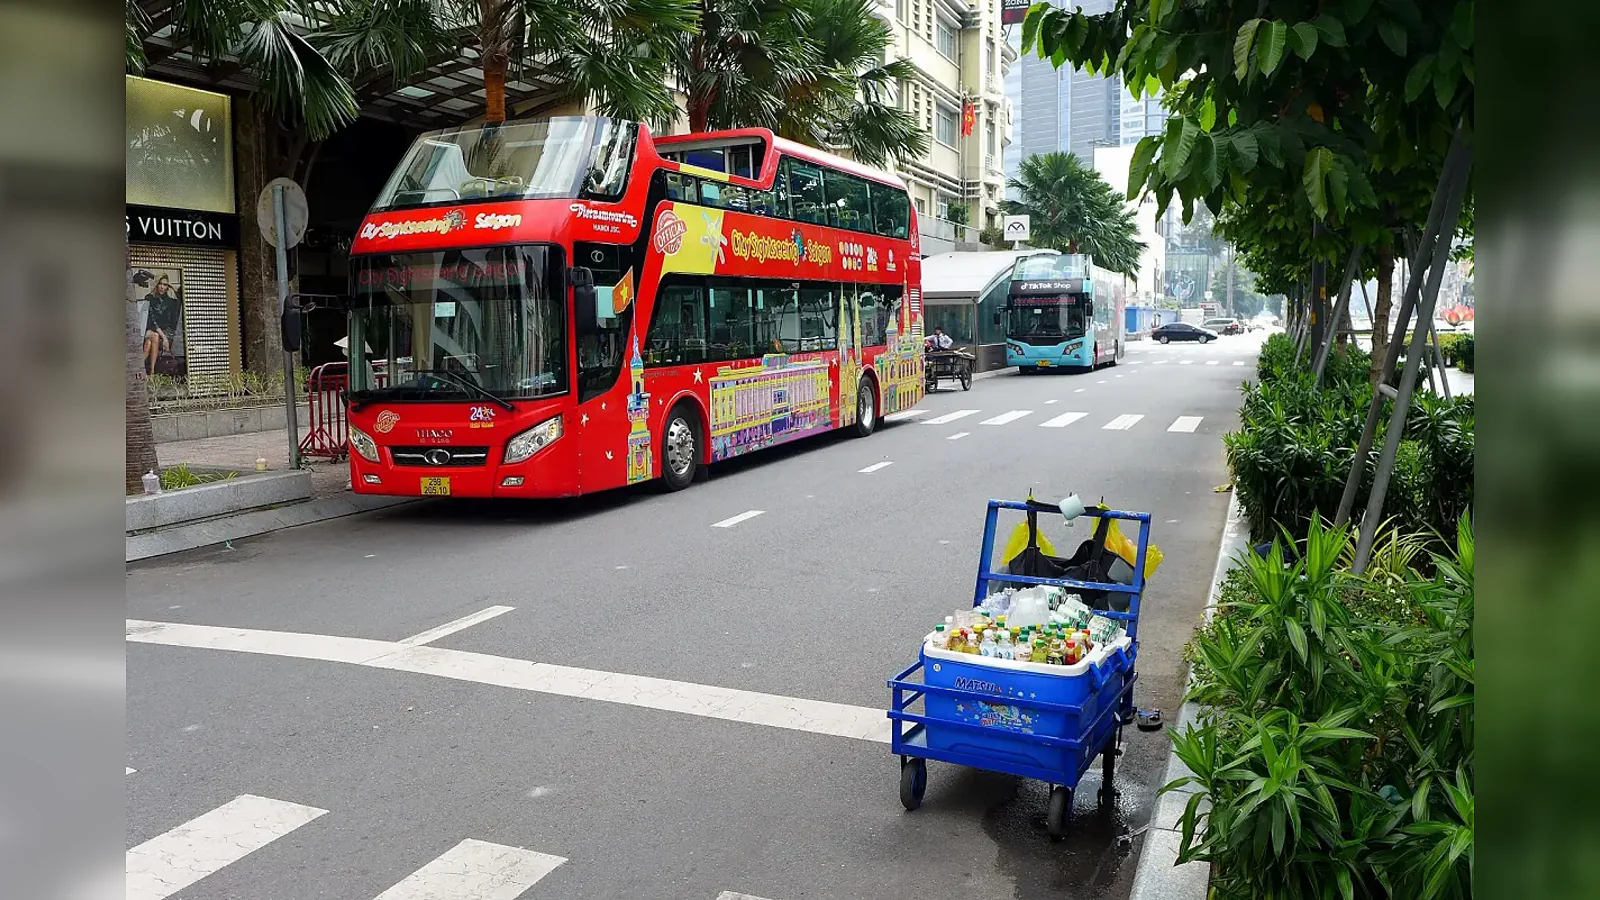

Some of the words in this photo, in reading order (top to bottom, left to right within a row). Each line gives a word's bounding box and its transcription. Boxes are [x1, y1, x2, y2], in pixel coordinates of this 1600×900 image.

[138, 216, 222, 240] VUITTON
[474, 213, 522, 230] Saigon
[807, 239, 832, 267] Saigon
[1028, 282, 1053, 290] TikTok
[1053, 282, 1071, 290] Shop
